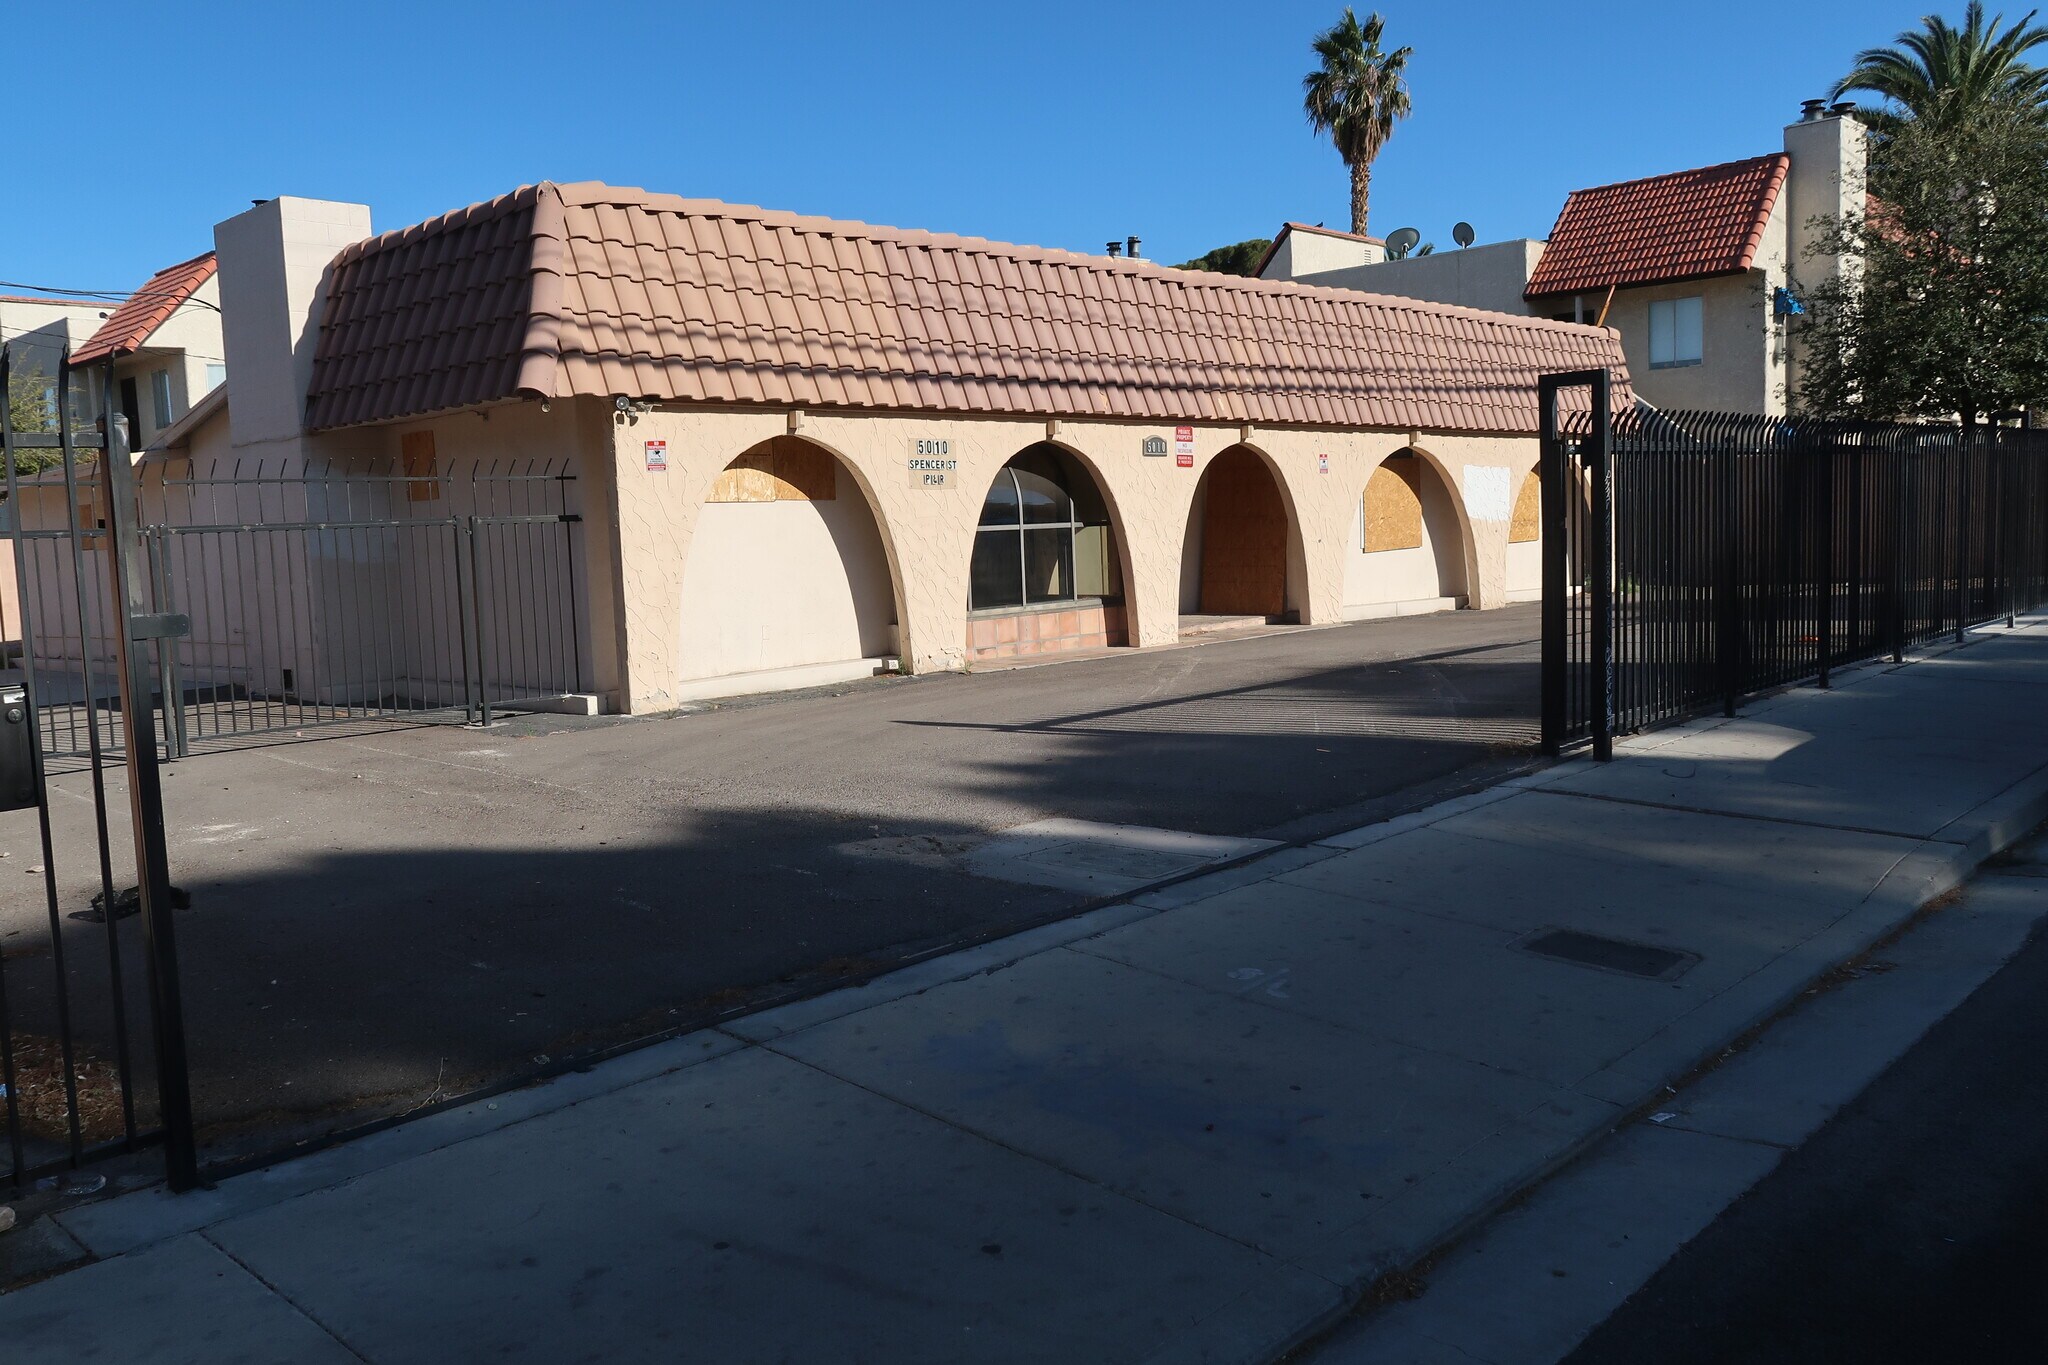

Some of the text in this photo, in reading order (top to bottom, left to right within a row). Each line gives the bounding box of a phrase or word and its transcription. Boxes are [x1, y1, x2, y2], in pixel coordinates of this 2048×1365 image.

[918, 440, 948, 454] 5010
[1147, 441, 1166, 453] 5010
[909, 459, 957, 470] SPENCER ST
